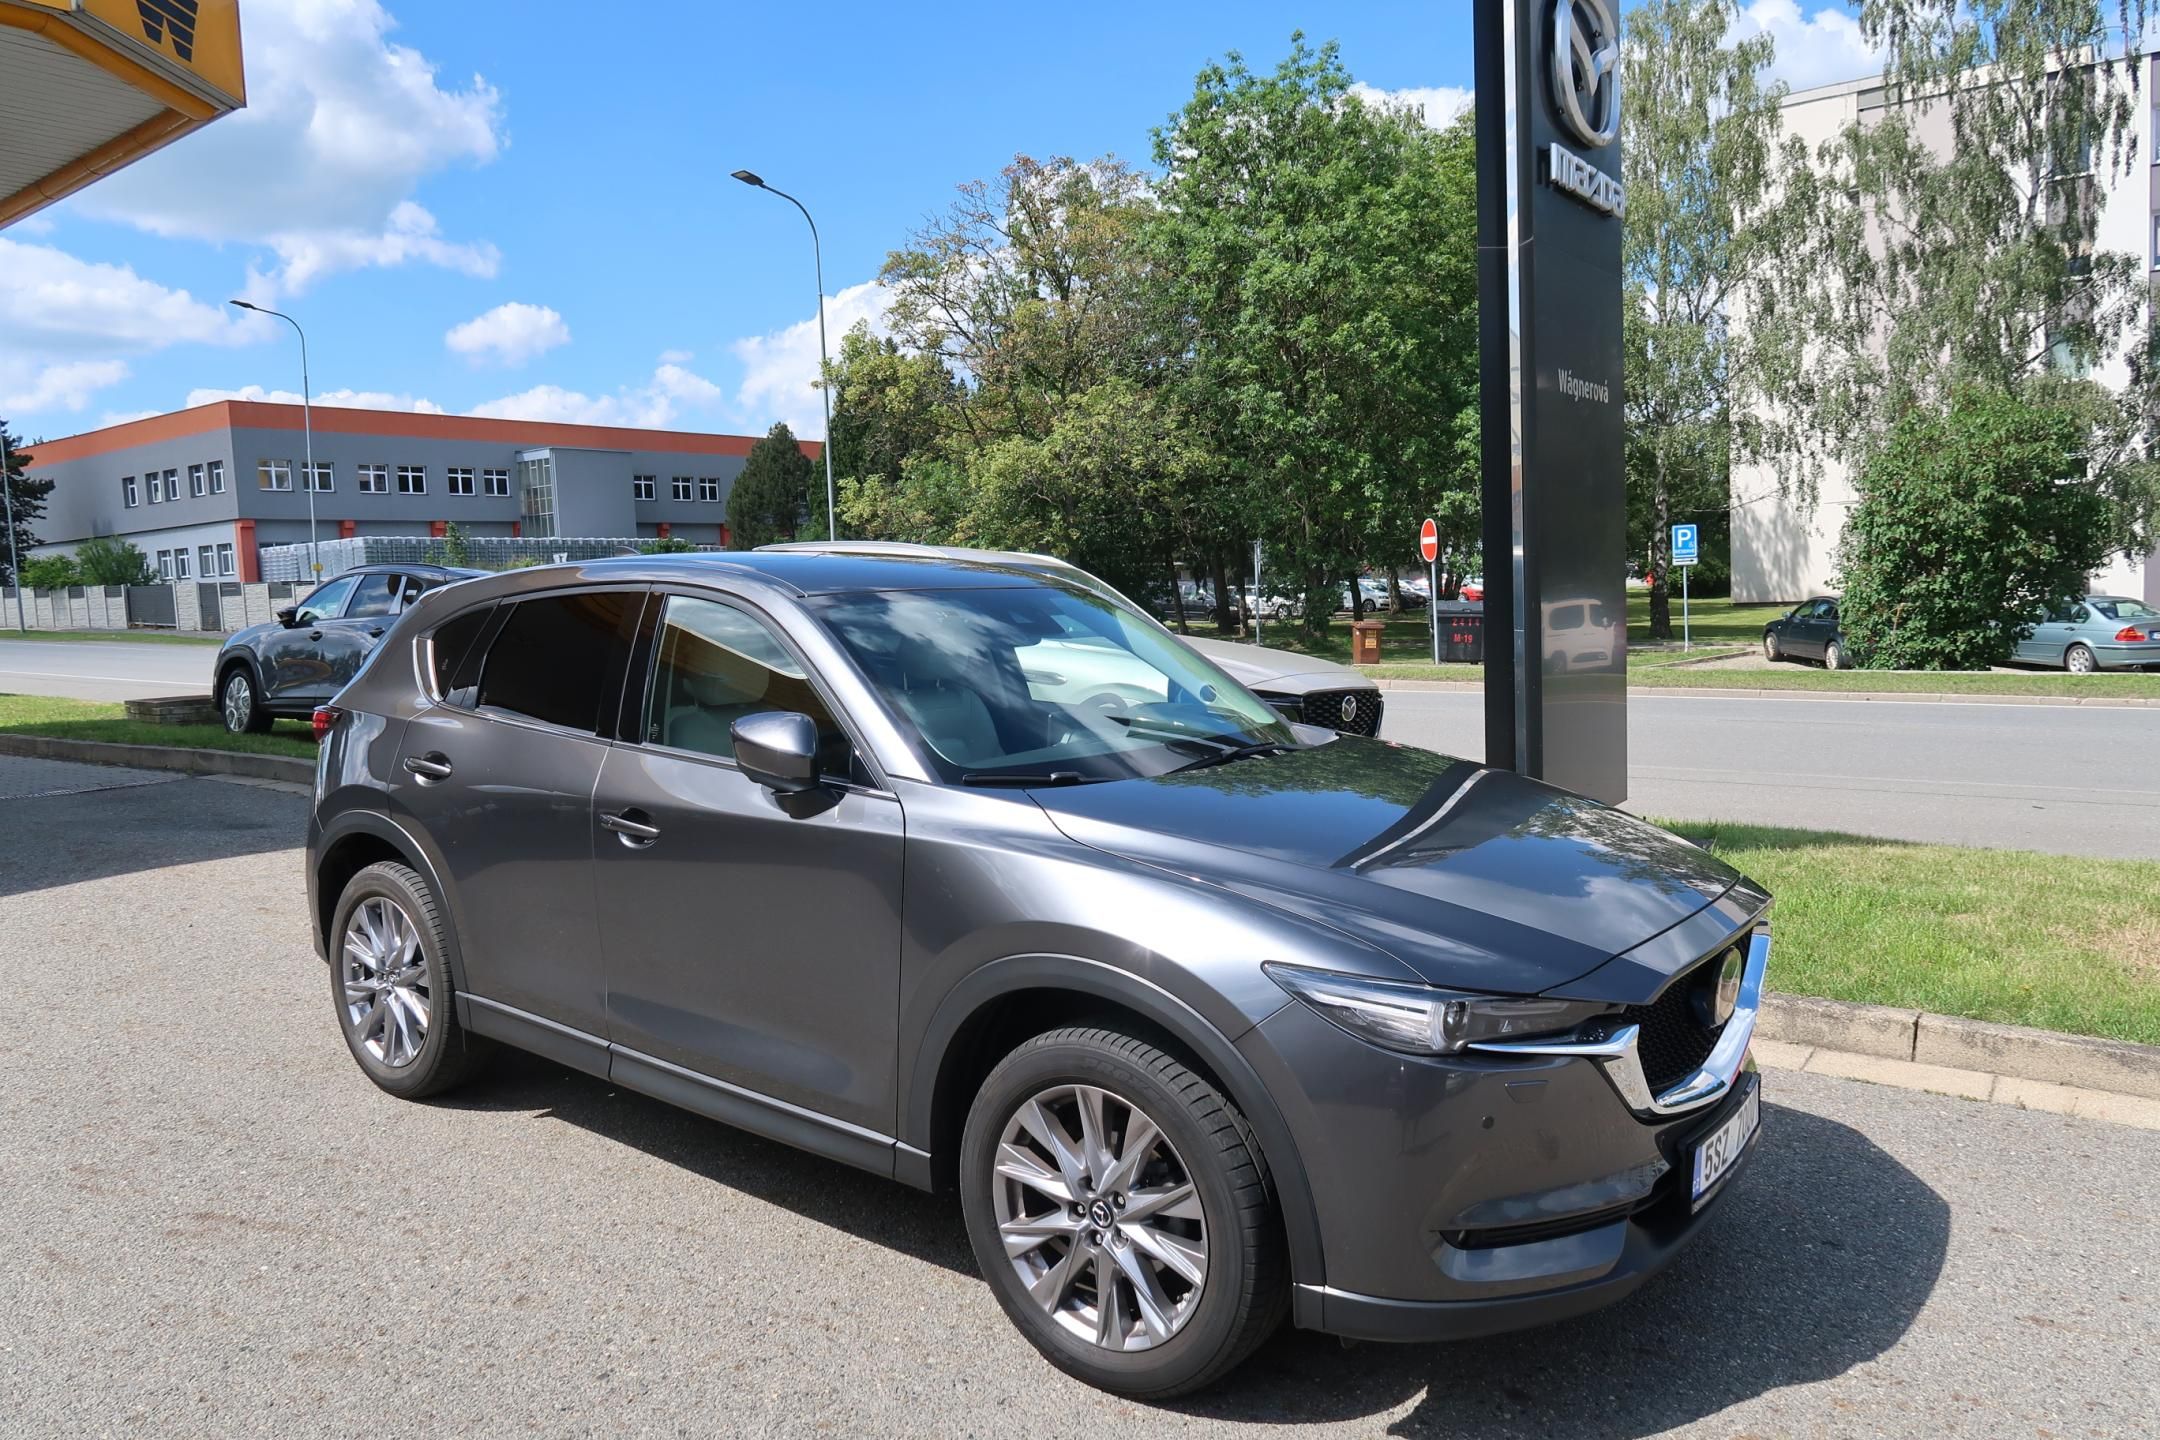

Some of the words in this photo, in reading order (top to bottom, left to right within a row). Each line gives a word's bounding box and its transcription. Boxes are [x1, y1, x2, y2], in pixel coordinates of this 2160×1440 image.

[1558, 368, 1608, 403] Wágnerová
[1677, 529, 1691, 547] P
[1704, 1124, 1729, 1182] 5SZ
